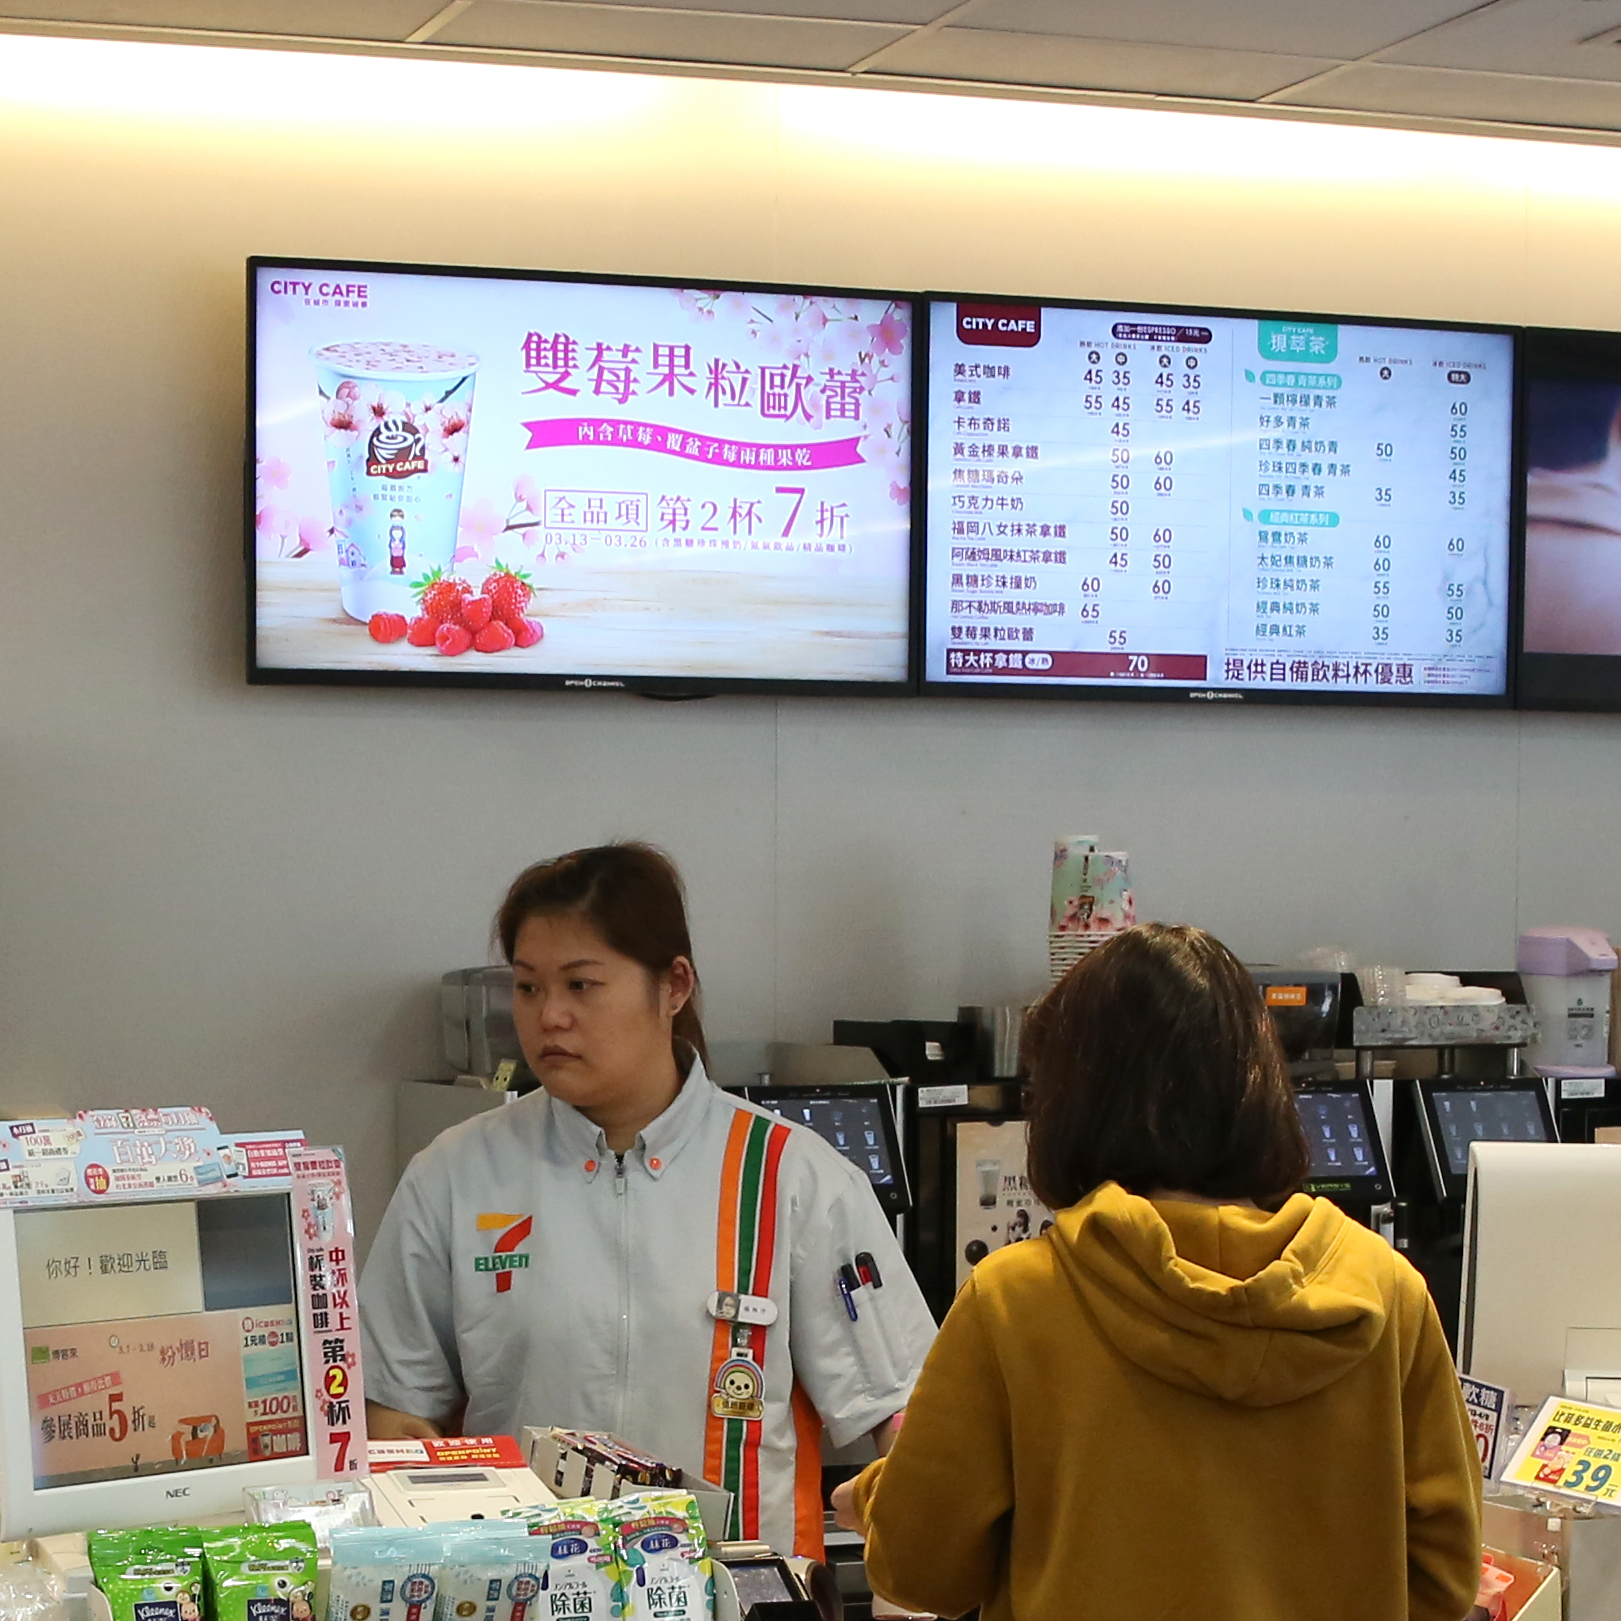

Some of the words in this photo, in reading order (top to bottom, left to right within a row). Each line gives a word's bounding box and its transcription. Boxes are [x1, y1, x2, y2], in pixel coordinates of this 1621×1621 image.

[270, 280, 313, 296] CITY
[318, 282, 368, 299] CAFE
[962, 316, 995, 332] CITY
[998, 319, 1036, 333] CAFE
[520, 330, 866, 424] 雙莓果粒歐蕾
[953, 362, 1011, 380] 美式咖啡
[1083, 369, 1103, 385] 45
[1112, 370, 1131, 386] 35
[1155, 373, 1174, 388] 45
[1182, 374, 1201, 389] 35
[953, 389, 981, 405] 拿鐵
[1083, 395, 1102, 410] 55
[1111, 396, 1130, 411] 45
[1154, 398, 1173, 413] 55
[1181, 400, 1200, 415] 45
[1450, 402, 1468, 416] 60
[953, 415, 1011, 432] 卡布奇諾
[1111, 422, 1130, 437] 45
[1259, 415, 1311, 431] 好多青茶
[1450, 424, 1467, 438] 55
[1110, 448, 1130, 463] 50
[1154, 450, 1173, 465] 60
[1376, 443, 1393, 457] 50
[1449, 447, 1467, 460] 50
[370, 460, 394, 474] CITY
[396, 458, 425, 471] CAFE
[952, 468, 1024, 485] 焦糖瑪奇朵
[1110, 474, 1130, 489] 50
[1154, 476, 1173, 491] 60
[1449, 469, 1466, 483] 45
[952, 495, 1024, 511] 巧克力牛奶
[1110, 500, 1129, 515] 50
[1375, 488, 1392, 502] 35
[1448, 491, 1466, 505] 35
[549, 496, 642, 527] 全品項
[1110, 526, 1129, 541] 50
[1153, 528, 1172, 543] 60
[1373, 535, 1391, 549] 60
[1109, 552, 1128, 568] 45
[1152, 554, 1172, 569] 50
[1373, 557, 1391, 572] 60
[951, 573, 1037, 590] 黑糖珍珠撞奶
[1081, 577, 1100, 592] 60
[1152, 580, 1171, 594] 60
[1373, 581, 1390, 595] 55
[1080, 603, 1099, 618] 65
[1372, 604, 1390, 618] 50
[950, 625, 1034, 642] 雙莓果粒歐蕾
[1108, 630, 1127, 645] 55
[1372, 627, 1389, 641] 35
[949, 652, 1023, 669] 特大杯拿鐵
[1128, 655, 1150, 671] 70
[1224, 658, 1415, 686] 提供自備飲料杯優惠
[308, 1255, 331, 1330] 杯裝咖啡
[328, 1246, 353, 1332] 中杯以上
[165, 1487, 191, 1499] NEC
[549, 1592, 593, 1617] 除菌
[646, 1585, 689, 1610] 除菌
